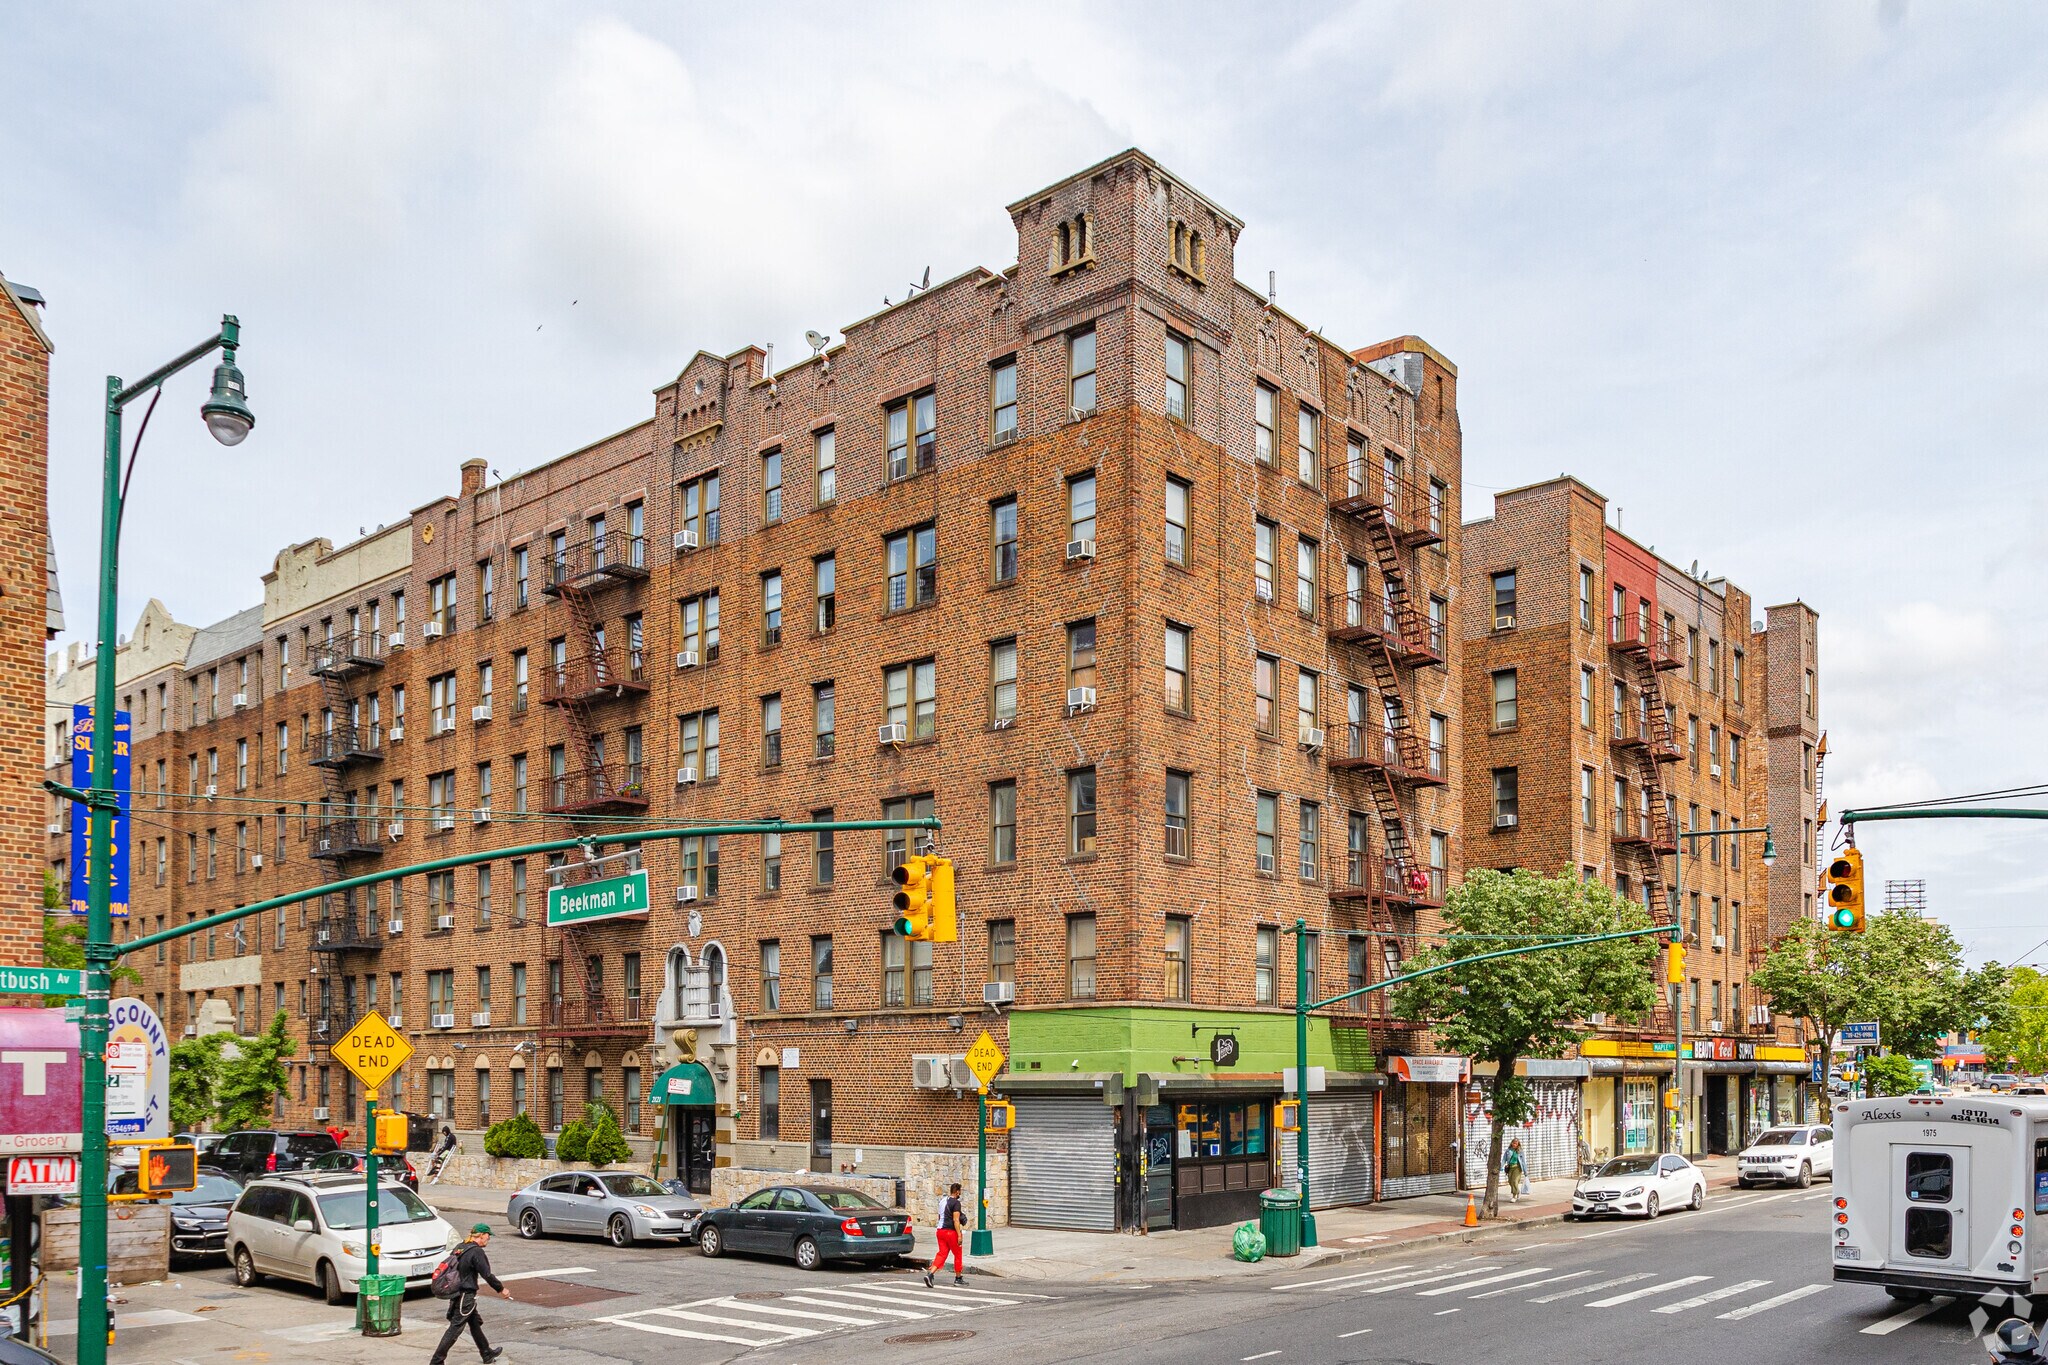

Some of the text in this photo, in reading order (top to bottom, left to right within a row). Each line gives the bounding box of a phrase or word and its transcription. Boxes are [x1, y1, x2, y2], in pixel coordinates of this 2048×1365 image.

[560, 883, 635, 914] Beekman Pl
[56, 973, 70, 984] Av
[352, 1036, 395, 1048] DEAD
[974, 1048, 996, 1057] DEAD
[1694, 1041, 1715, 1059] BEAUTY
[358, 1055, 389, 1067] END
[976, 1062, 993, 1072] END
[1861, 1108, 1902, 1121] Alexis
[1961, 1108, 1988, 1117] (917)
[1950, 1114, 2000, 1125] 434-1614
[1922, 1129, 1937, 1137] 1975
[14, 1135, 68, 1148] Grocery
[13, 1159, 72, 1183] ATM
